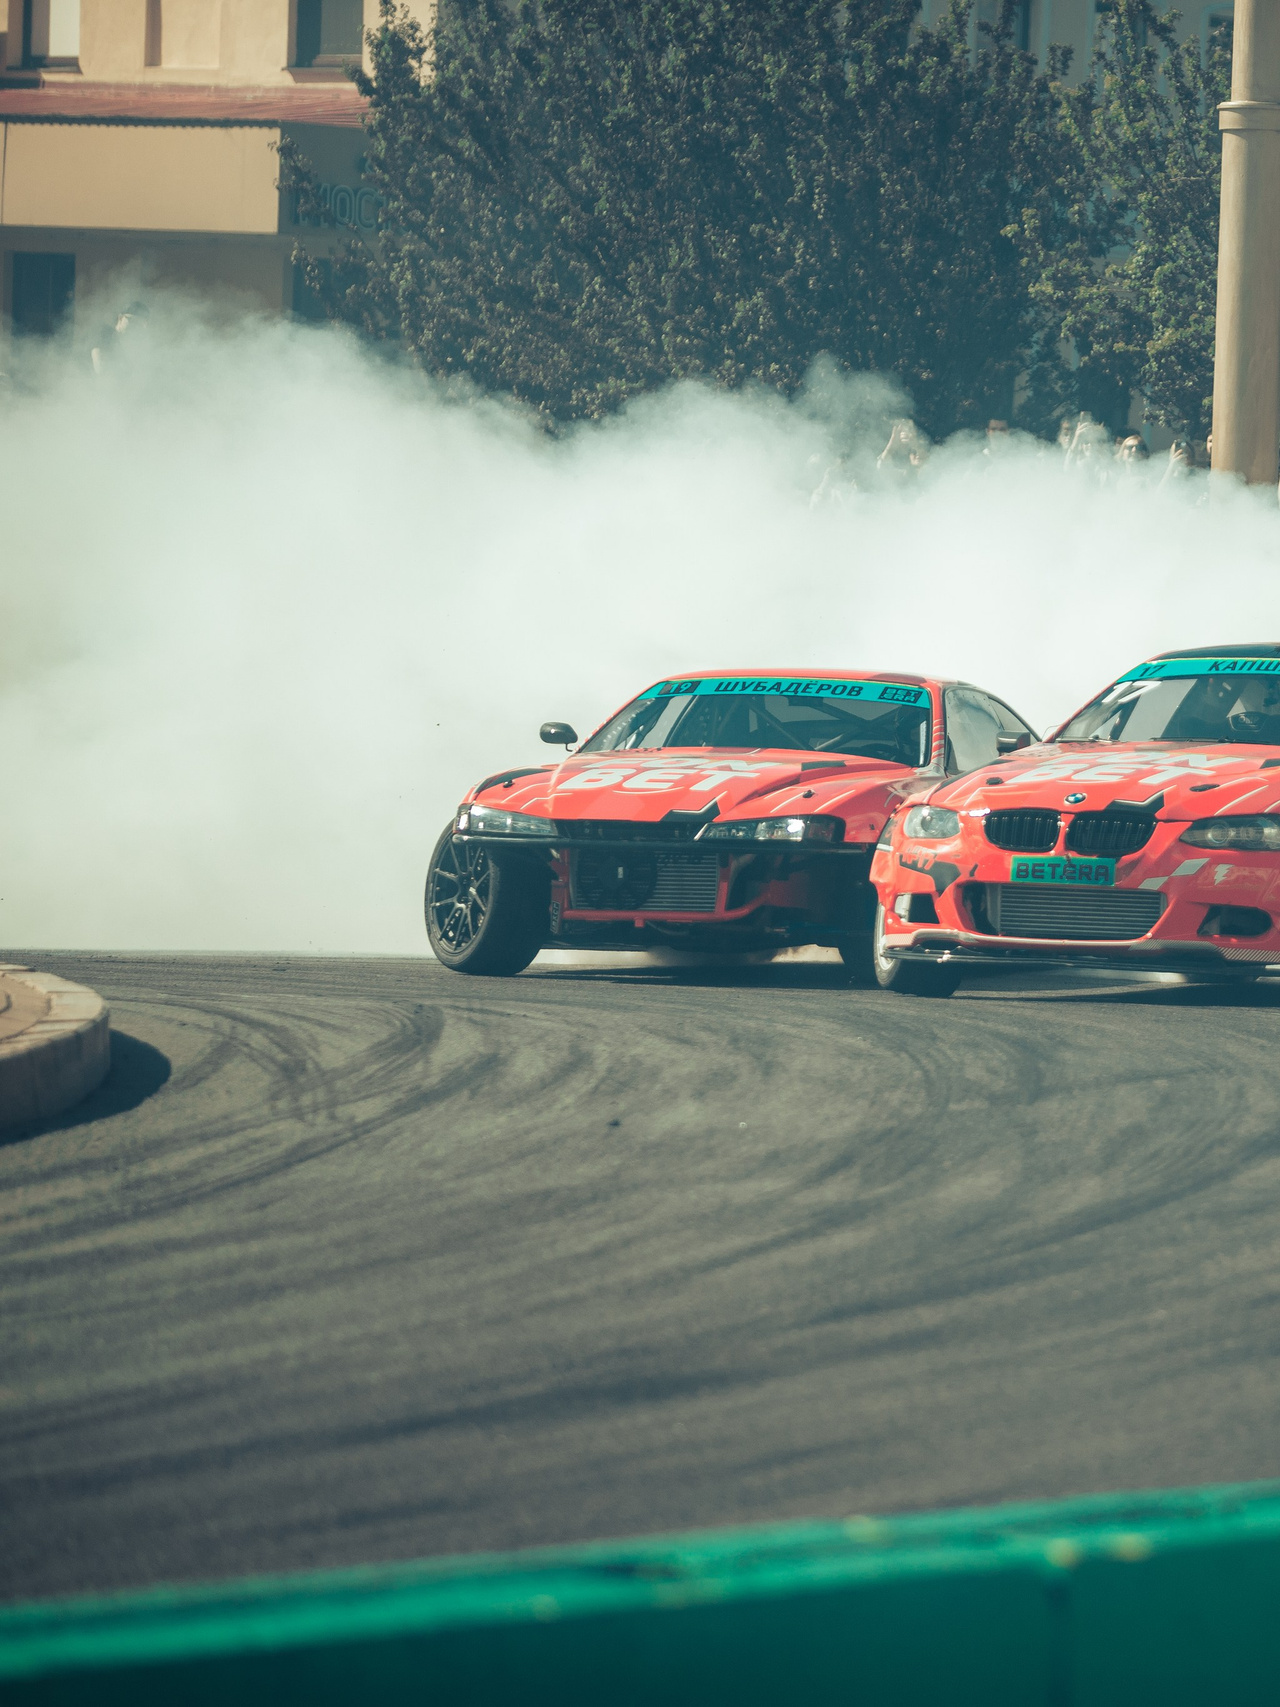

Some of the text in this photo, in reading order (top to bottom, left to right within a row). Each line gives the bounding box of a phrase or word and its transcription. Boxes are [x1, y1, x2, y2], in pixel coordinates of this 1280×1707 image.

[1138, 664, 1167, 678] 17
[669, 682, 692, 693] 19
[714, 680, 864, 697] ШУБАДЁРОВ
[1102, 681, 1162, 703] 17
[580, 757, 783, 771] FON
[1036, 752, 1247, 768] FON
[556, 768, 761, 791] BET
[1003, 763, 1217, 785] BET
[1015, 862, 1110, 882] BET.ERA
